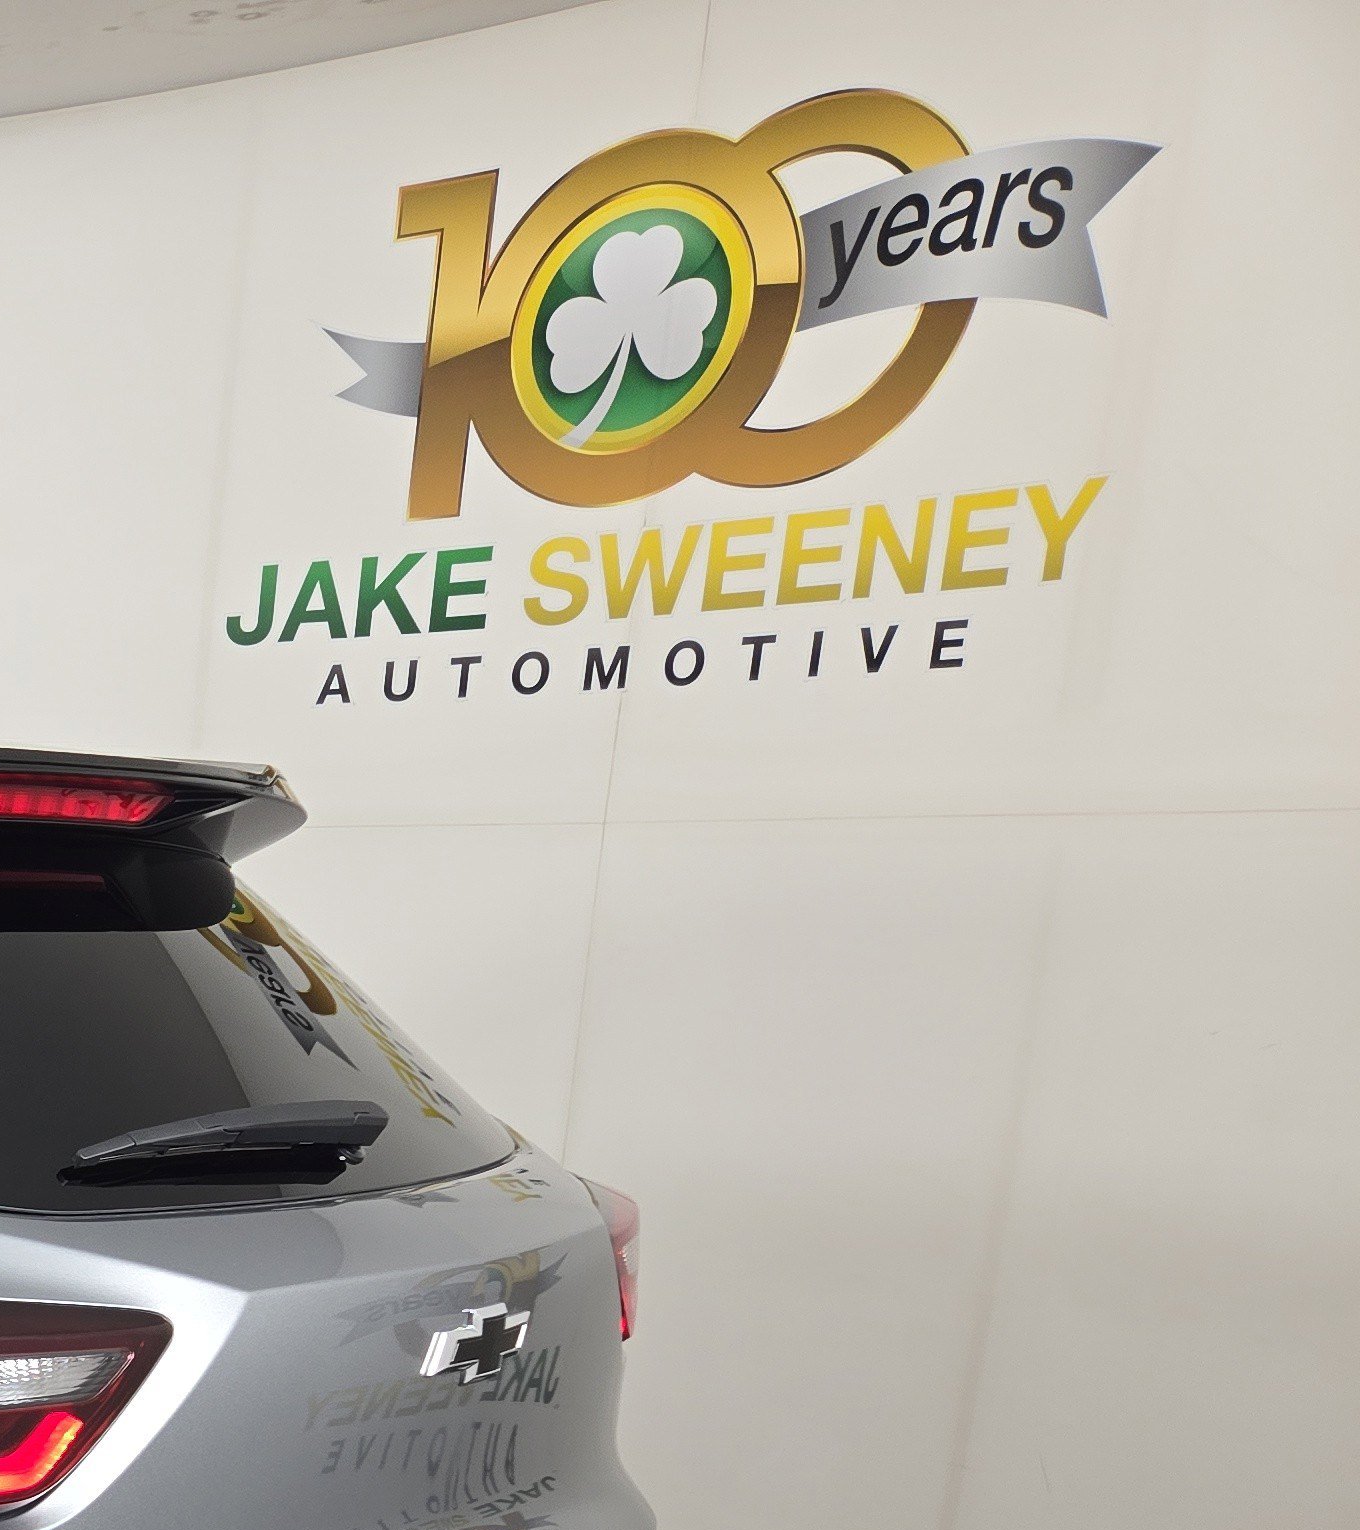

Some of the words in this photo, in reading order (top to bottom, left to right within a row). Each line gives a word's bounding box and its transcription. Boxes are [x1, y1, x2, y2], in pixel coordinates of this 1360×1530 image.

[395, 86, 979, 521] 100
[817, 161, 1074, 310] years
[226, 546, 493, 646] JAKE
[523, 475, 1109, 627] SWEENEY
[316, 618, 969, 705] AUTOMOTIVE
